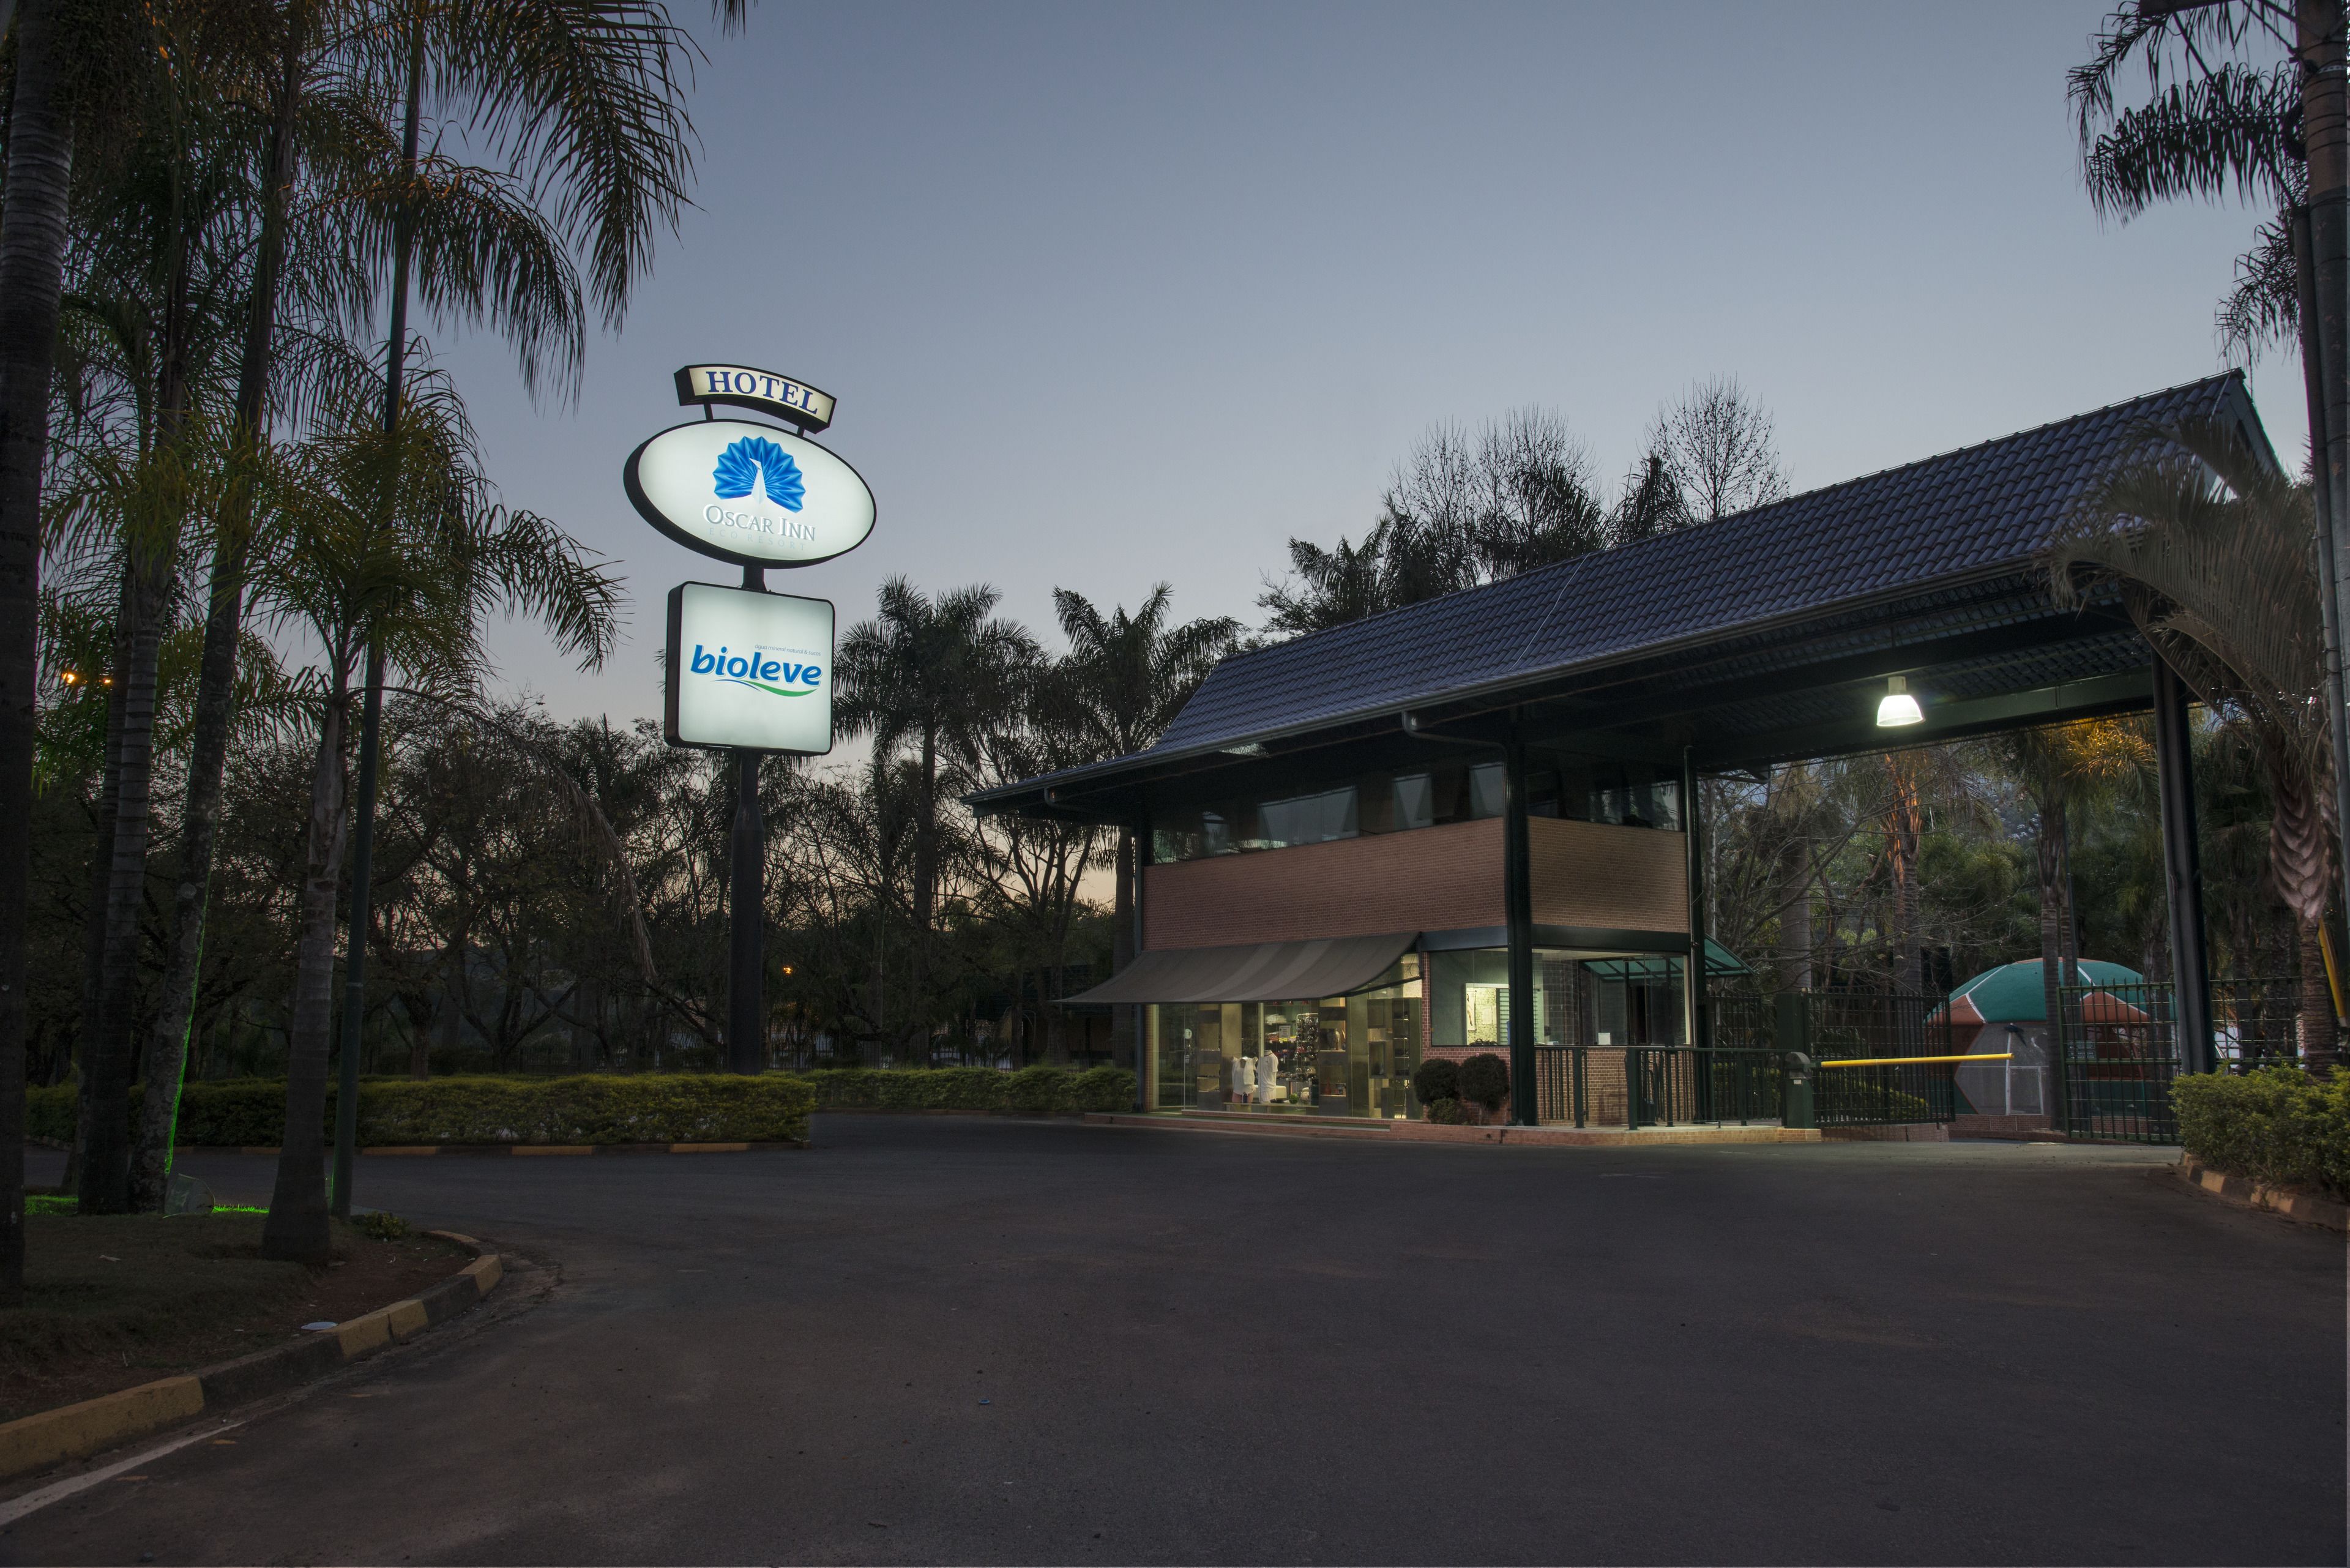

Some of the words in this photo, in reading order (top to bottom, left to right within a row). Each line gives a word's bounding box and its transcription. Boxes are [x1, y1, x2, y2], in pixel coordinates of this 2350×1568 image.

[706, 371, 818, 415] HOTEL
[709, 527, 738, 539] ECO
[747, 534, 806, 551] RESORT
[690, 644, 822, 685] bioleve
